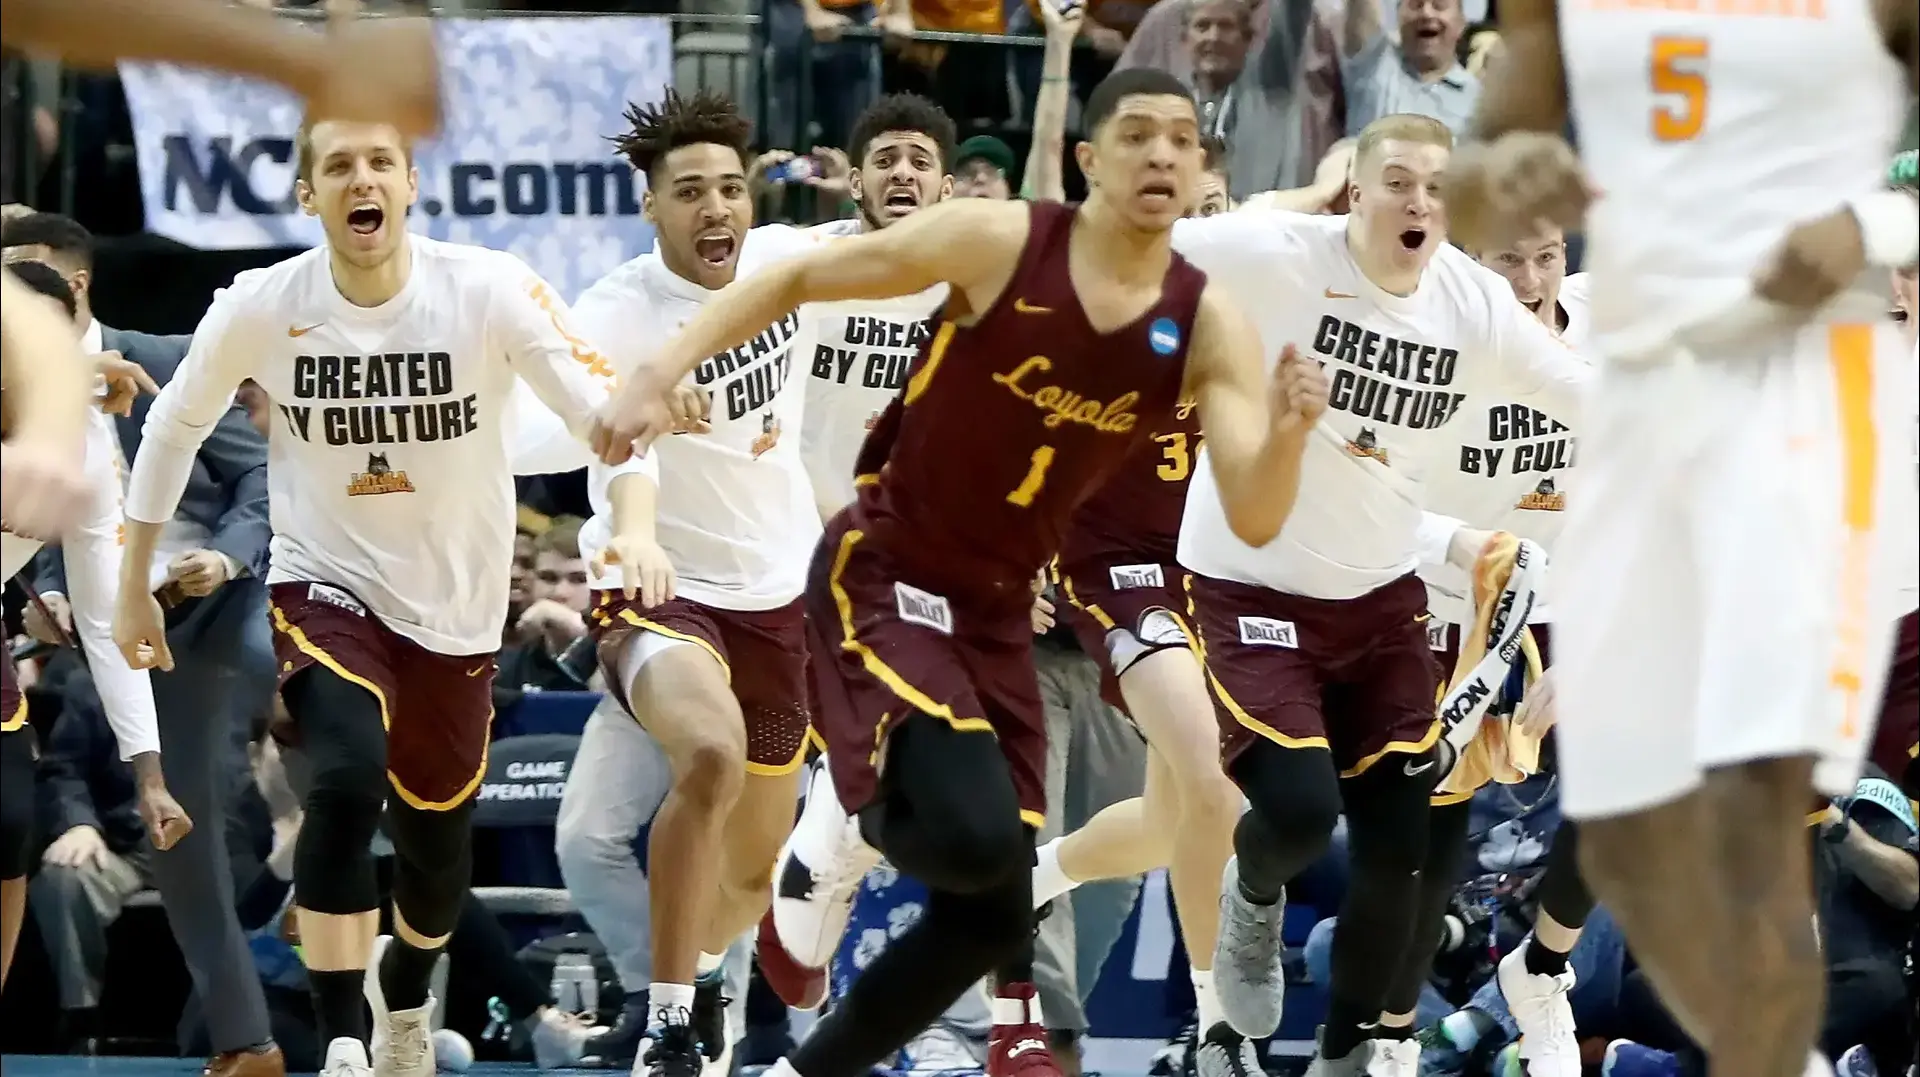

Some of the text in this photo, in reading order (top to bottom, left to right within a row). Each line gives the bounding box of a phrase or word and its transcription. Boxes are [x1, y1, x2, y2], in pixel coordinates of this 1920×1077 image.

[1651, 36, 1709, 142] 5
[294, 352, 453, 399] CREATED
[811, 344, 858, 384] BY
[1312, 314, 1460, 387] CREATED
[323, 393, 479, 446] CULTURE
[991, 355, 1141, 434] Loyola
[1005, 444, 1056, 508] 1
[1154, 431, 1204, 482] 3
[1459, 445, 1505, 478] BY
[506, 761, 566, 780] GAME
